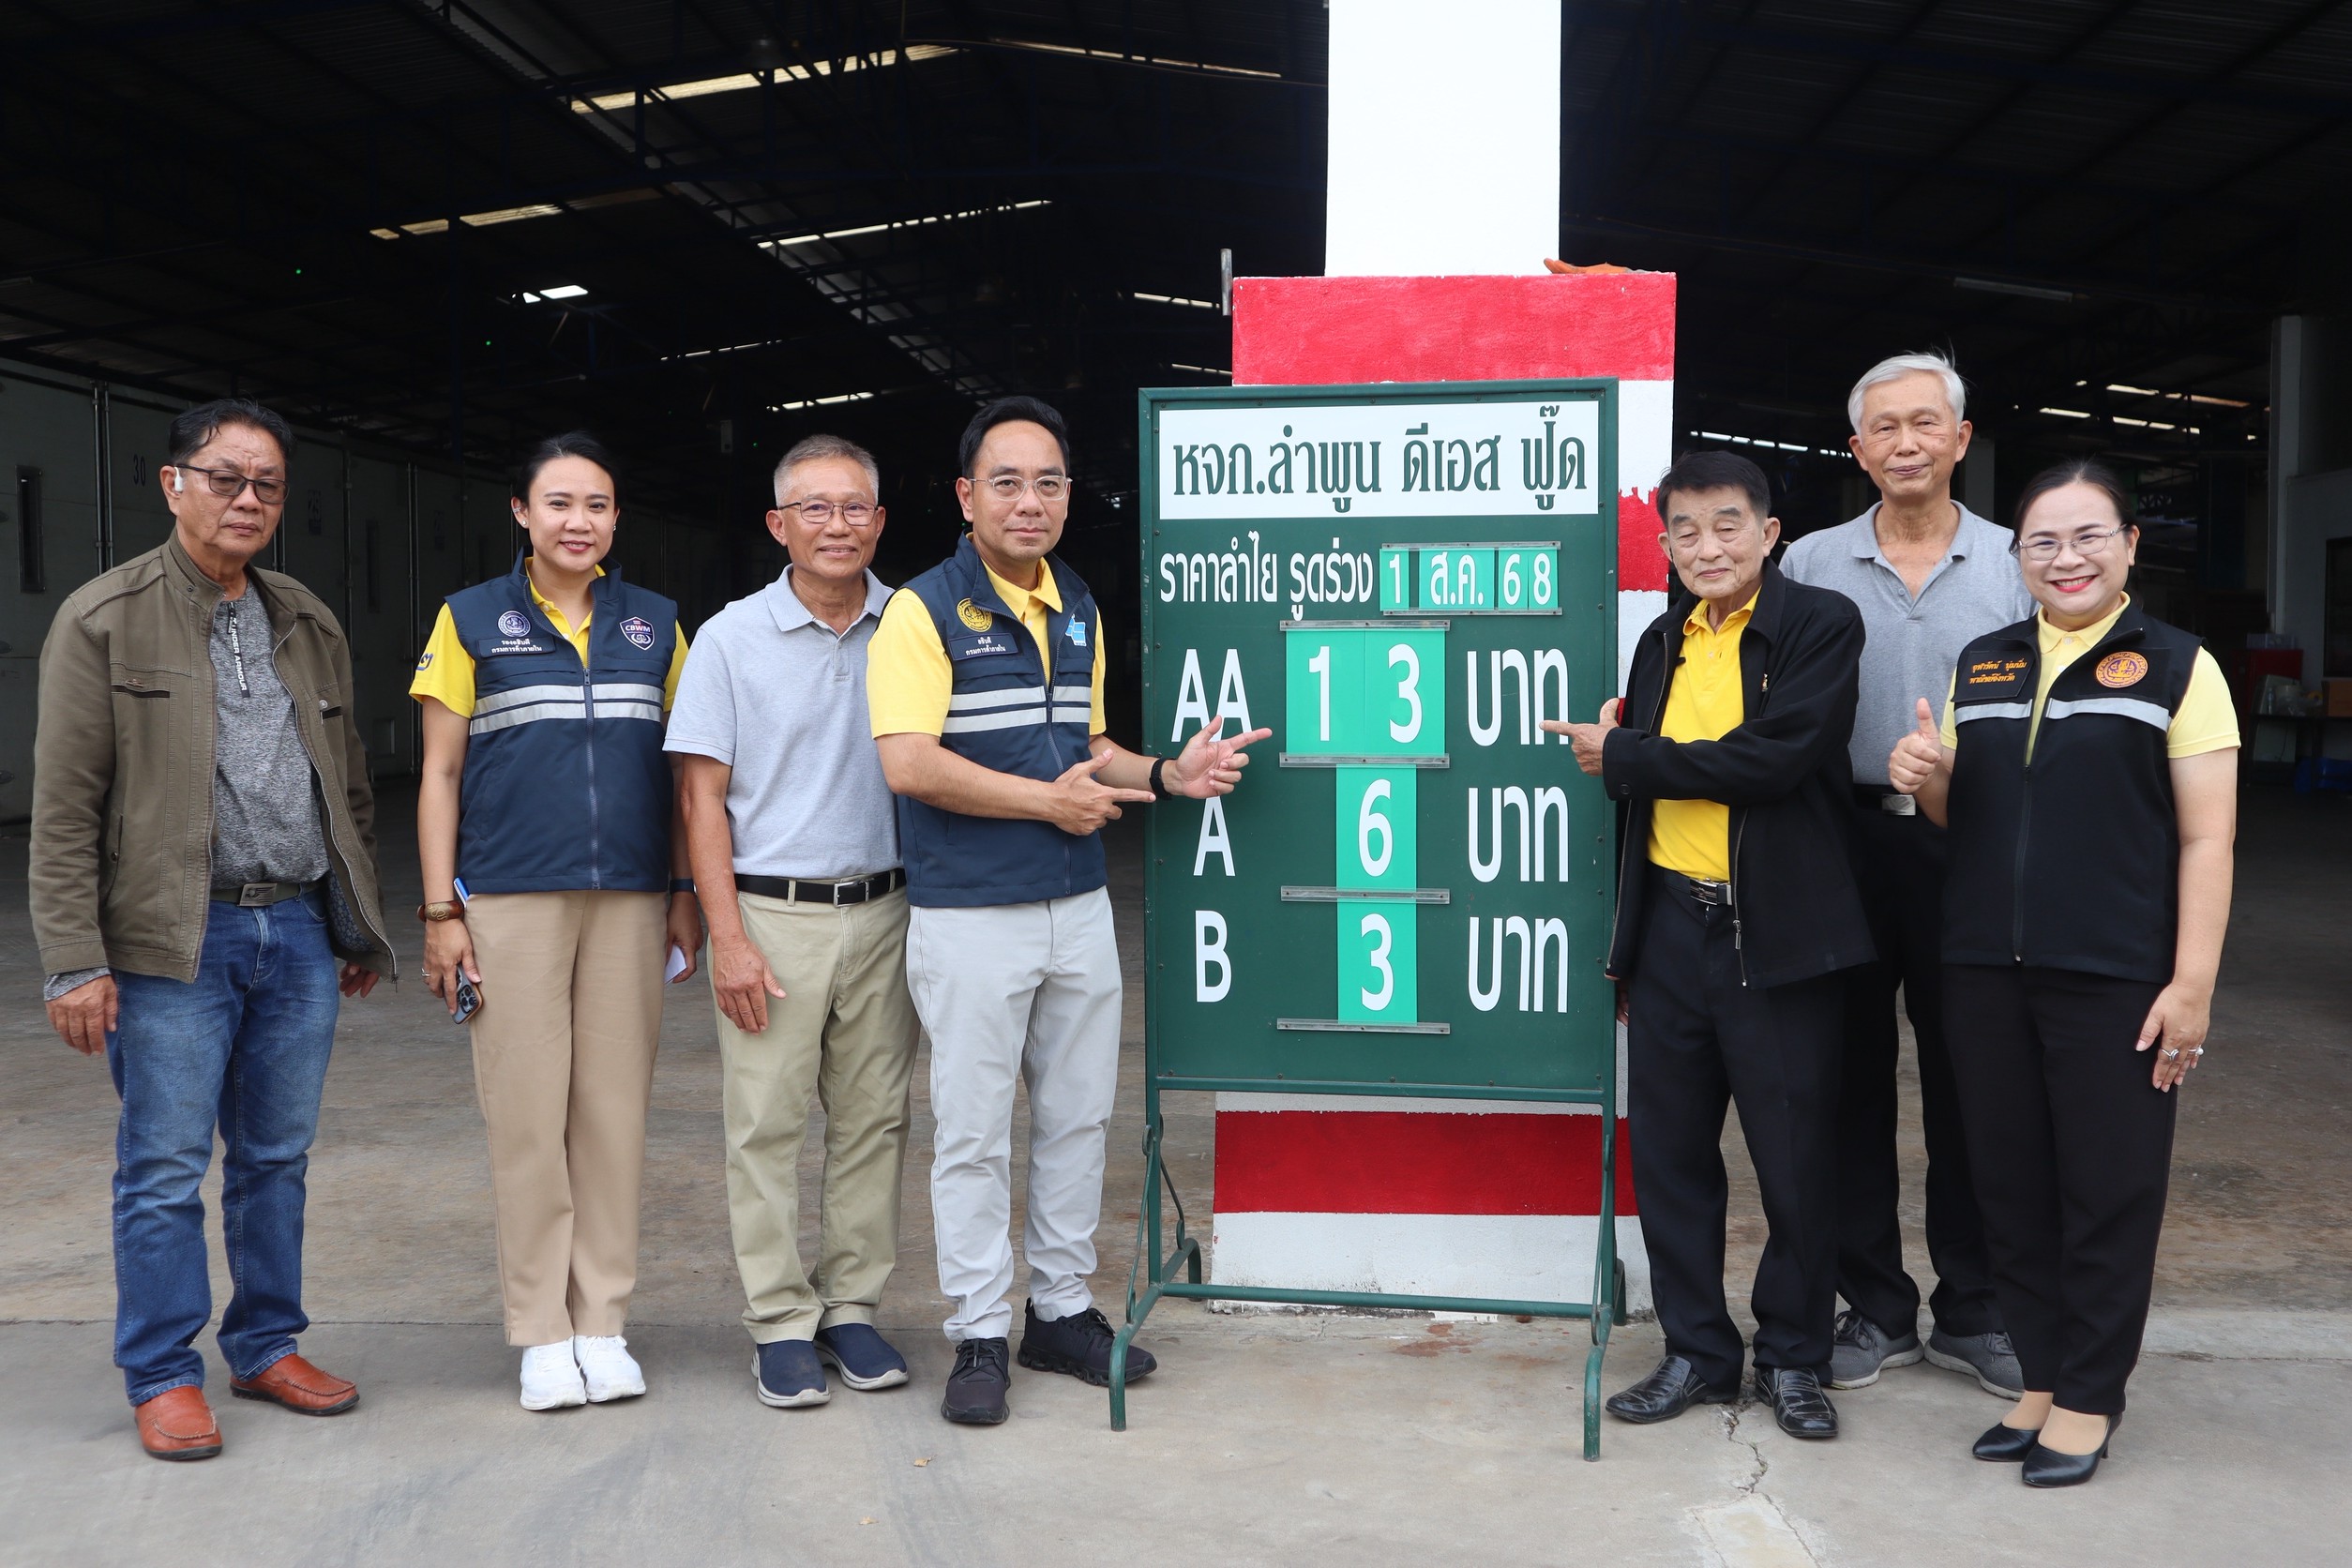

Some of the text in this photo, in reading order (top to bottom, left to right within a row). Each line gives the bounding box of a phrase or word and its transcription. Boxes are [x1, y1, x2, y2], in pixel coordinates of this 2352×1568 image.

[133, 454, 146, 487] 30
[1172, 404, 1588, 514] หจก.ลำพูน ดีเอส ฟู๊ด
[1160, 530, 1552, 621] ราคาลำไย รูดร่วง 1 ส.ค. 68
[234, 655, 248, 691] ARMOUR
[490, 644, 543, 654] กรมการค้าภายใน
[625, 625, 651, 633] CBWM
[1170, 649, 1252, 743] AA
[1467, 648, 1569, 746] บาท
[1193, 778, 1569, 882] A 6 บาท
[1195, 910, 1568, 1014] B 3 บาท
